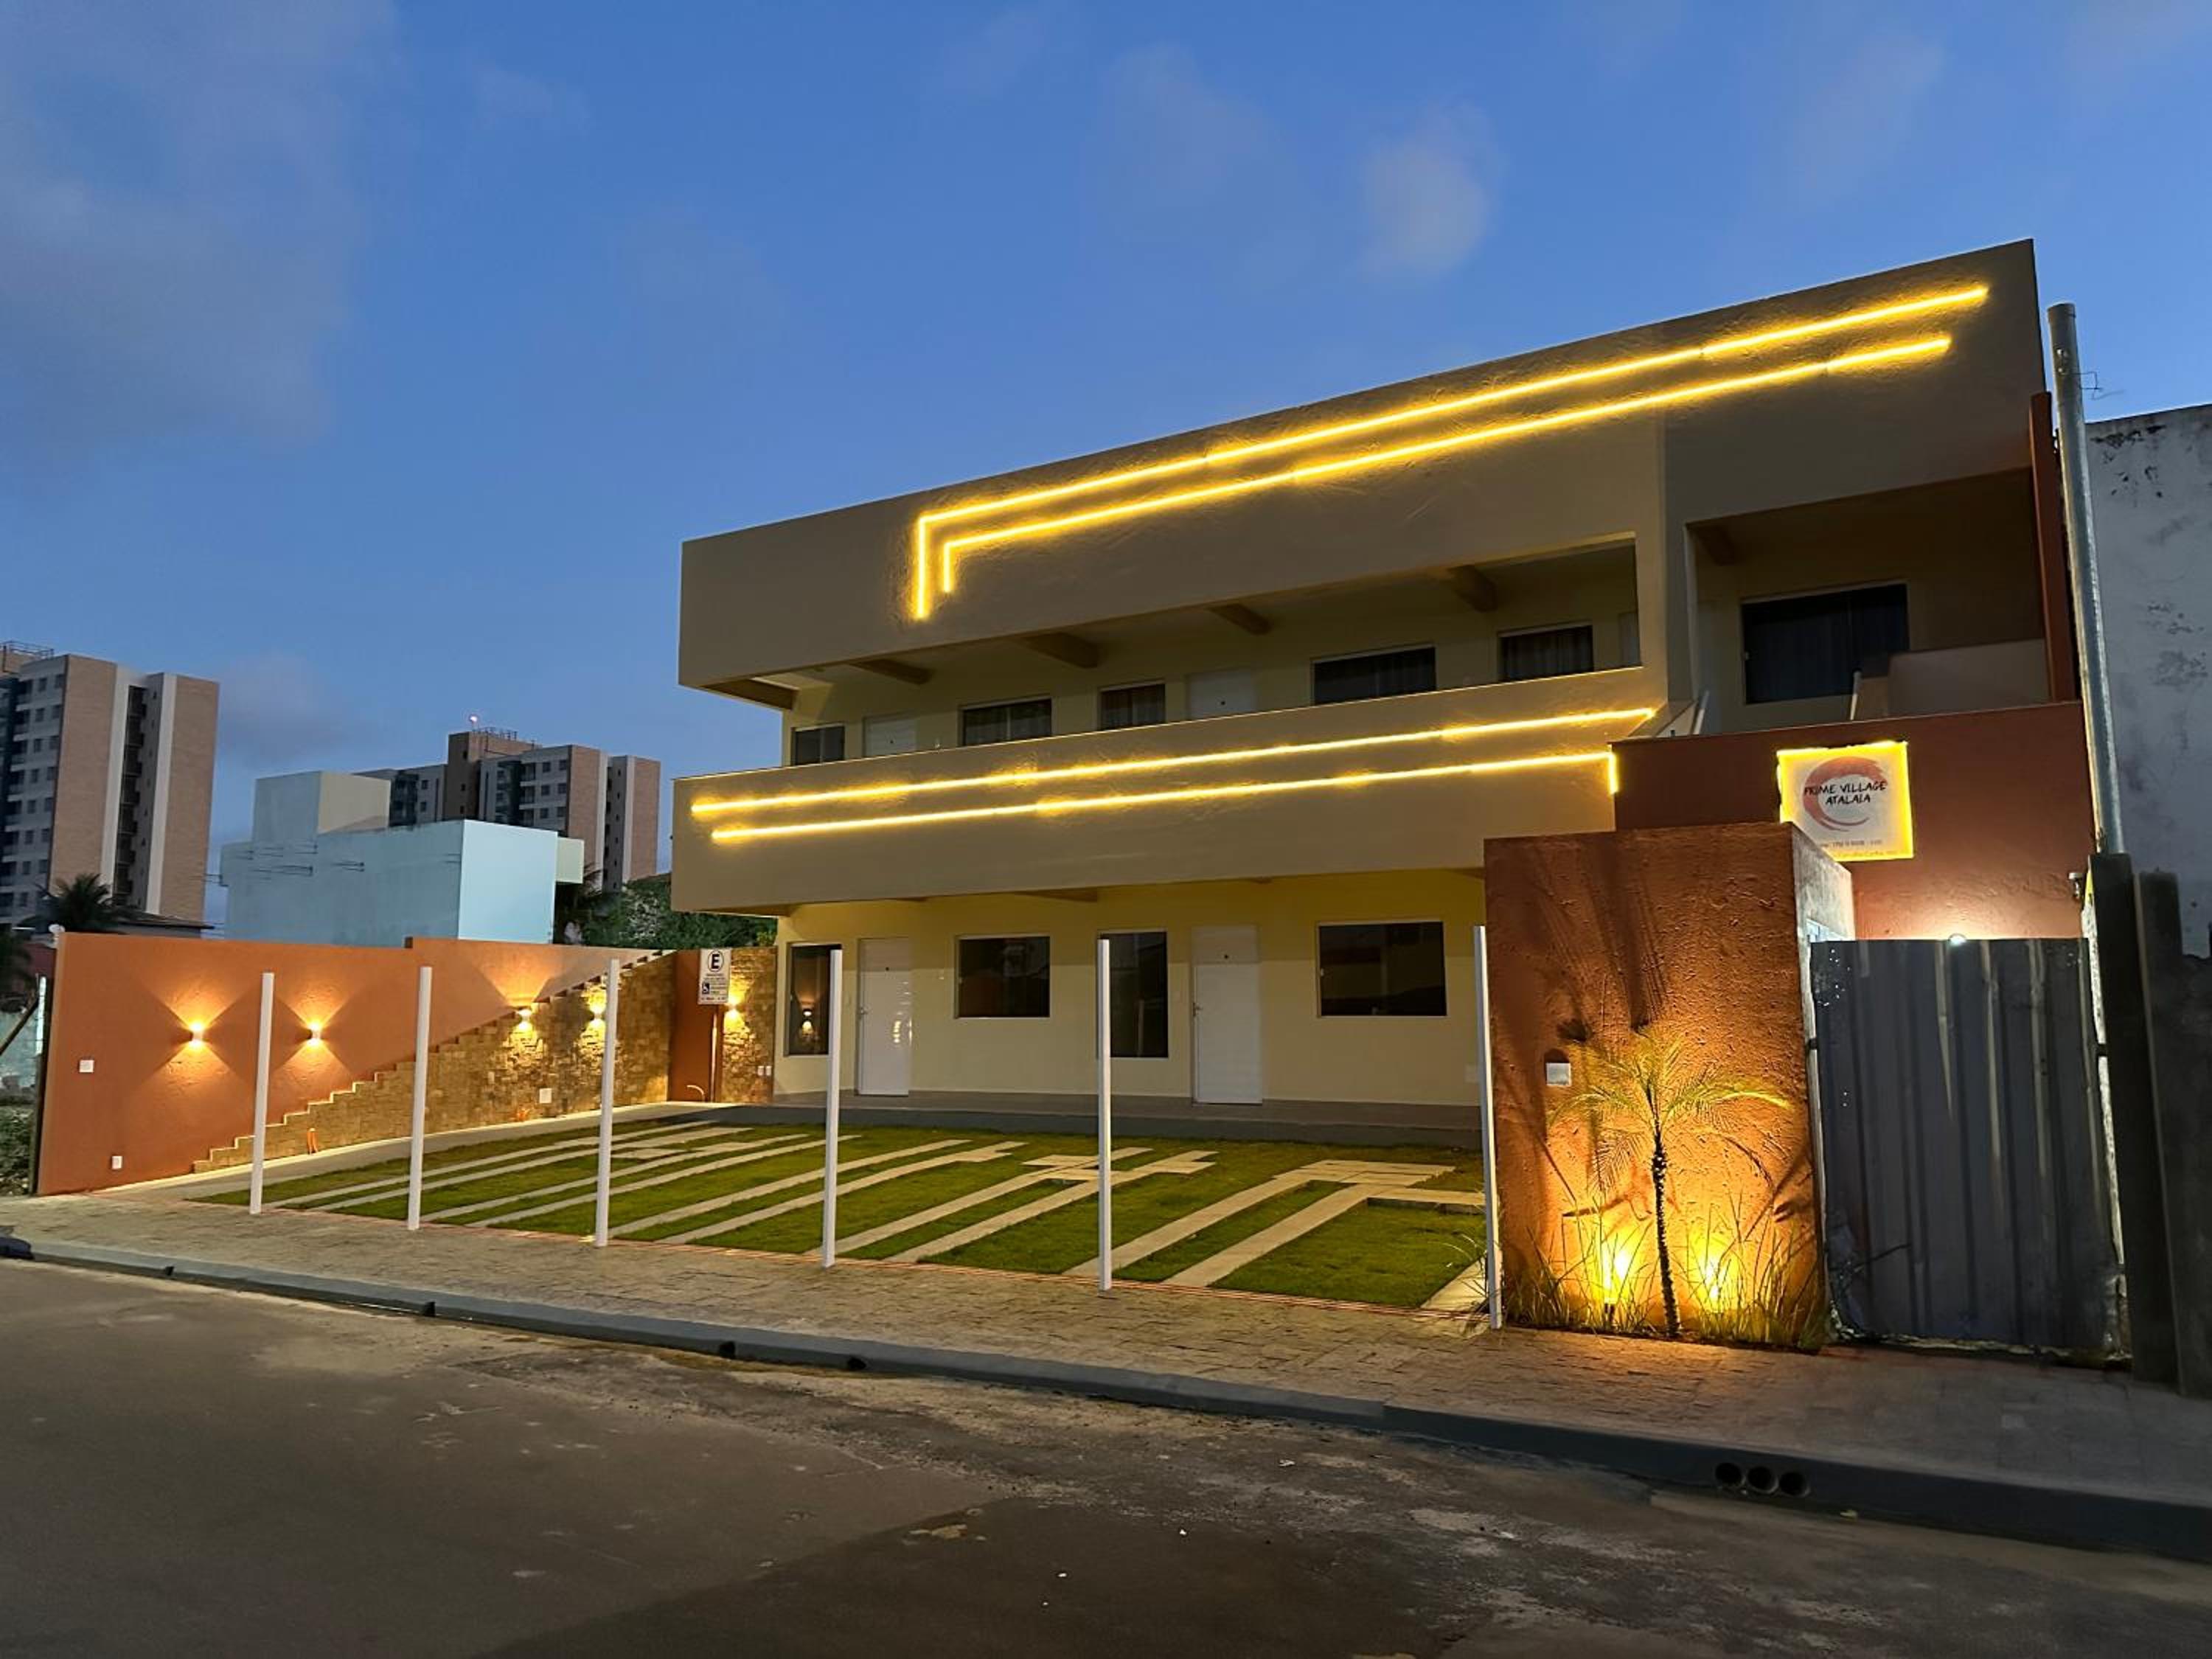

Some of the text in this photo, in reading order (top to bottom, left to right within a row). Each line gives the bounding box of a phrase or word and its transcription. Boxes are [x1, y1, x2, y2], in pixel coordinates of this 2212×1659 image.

[1804, 780, 1886, 795] PRIME VILLAGE
[1825, 793, 1871, 805] ATALAIA
[712, 953, 720, 969] E
